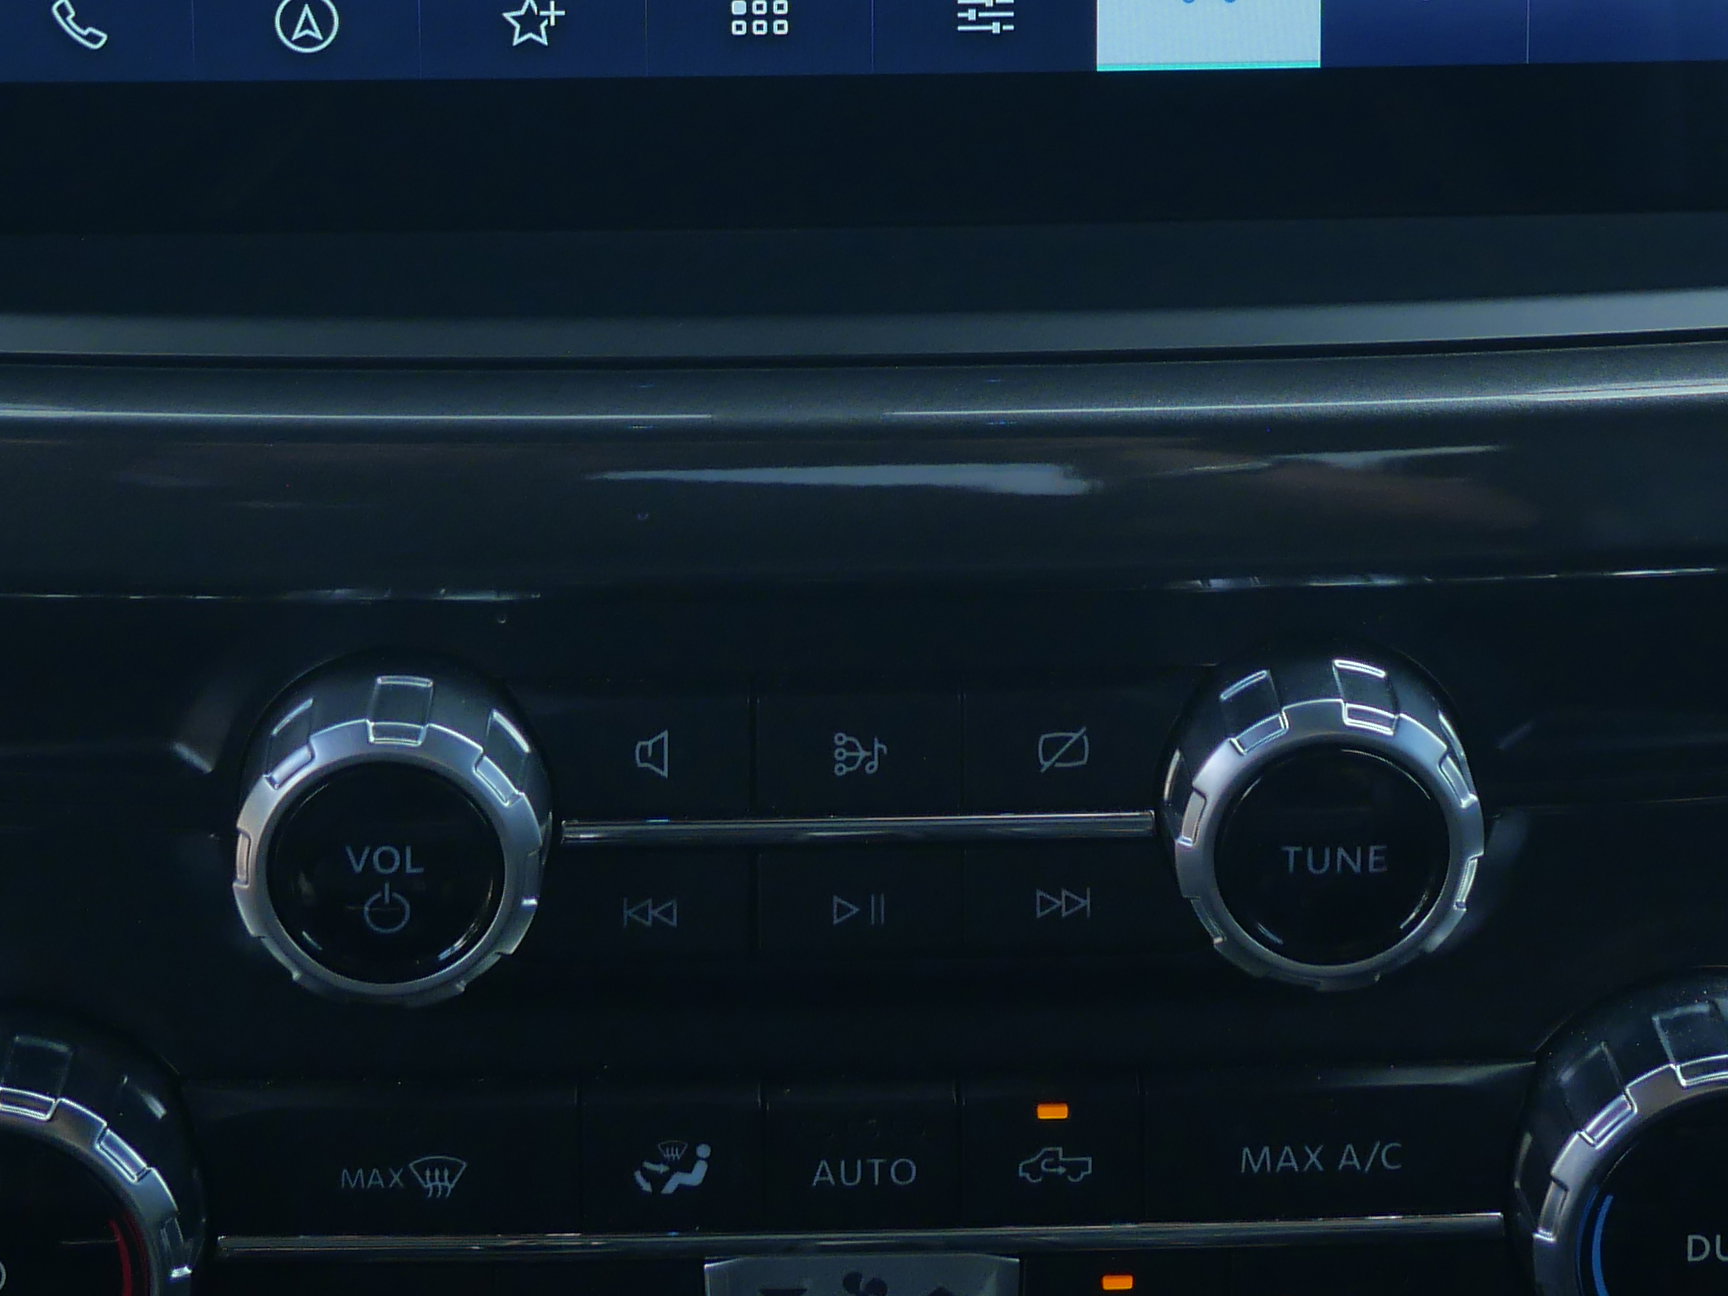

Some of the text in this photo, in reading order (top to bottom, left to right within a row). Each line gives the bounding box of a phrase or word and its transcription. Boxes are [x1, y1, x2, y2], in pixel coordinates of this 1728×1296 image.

[345, 845, 424, 875] VOL
[1282, 845, 1386, 875] TUNE
[811, 1158, 917, 1187] AUTO
[1241, 1141, 1401, 1174] MAX A/C
[340, 1167, 404, 1189] MAX
